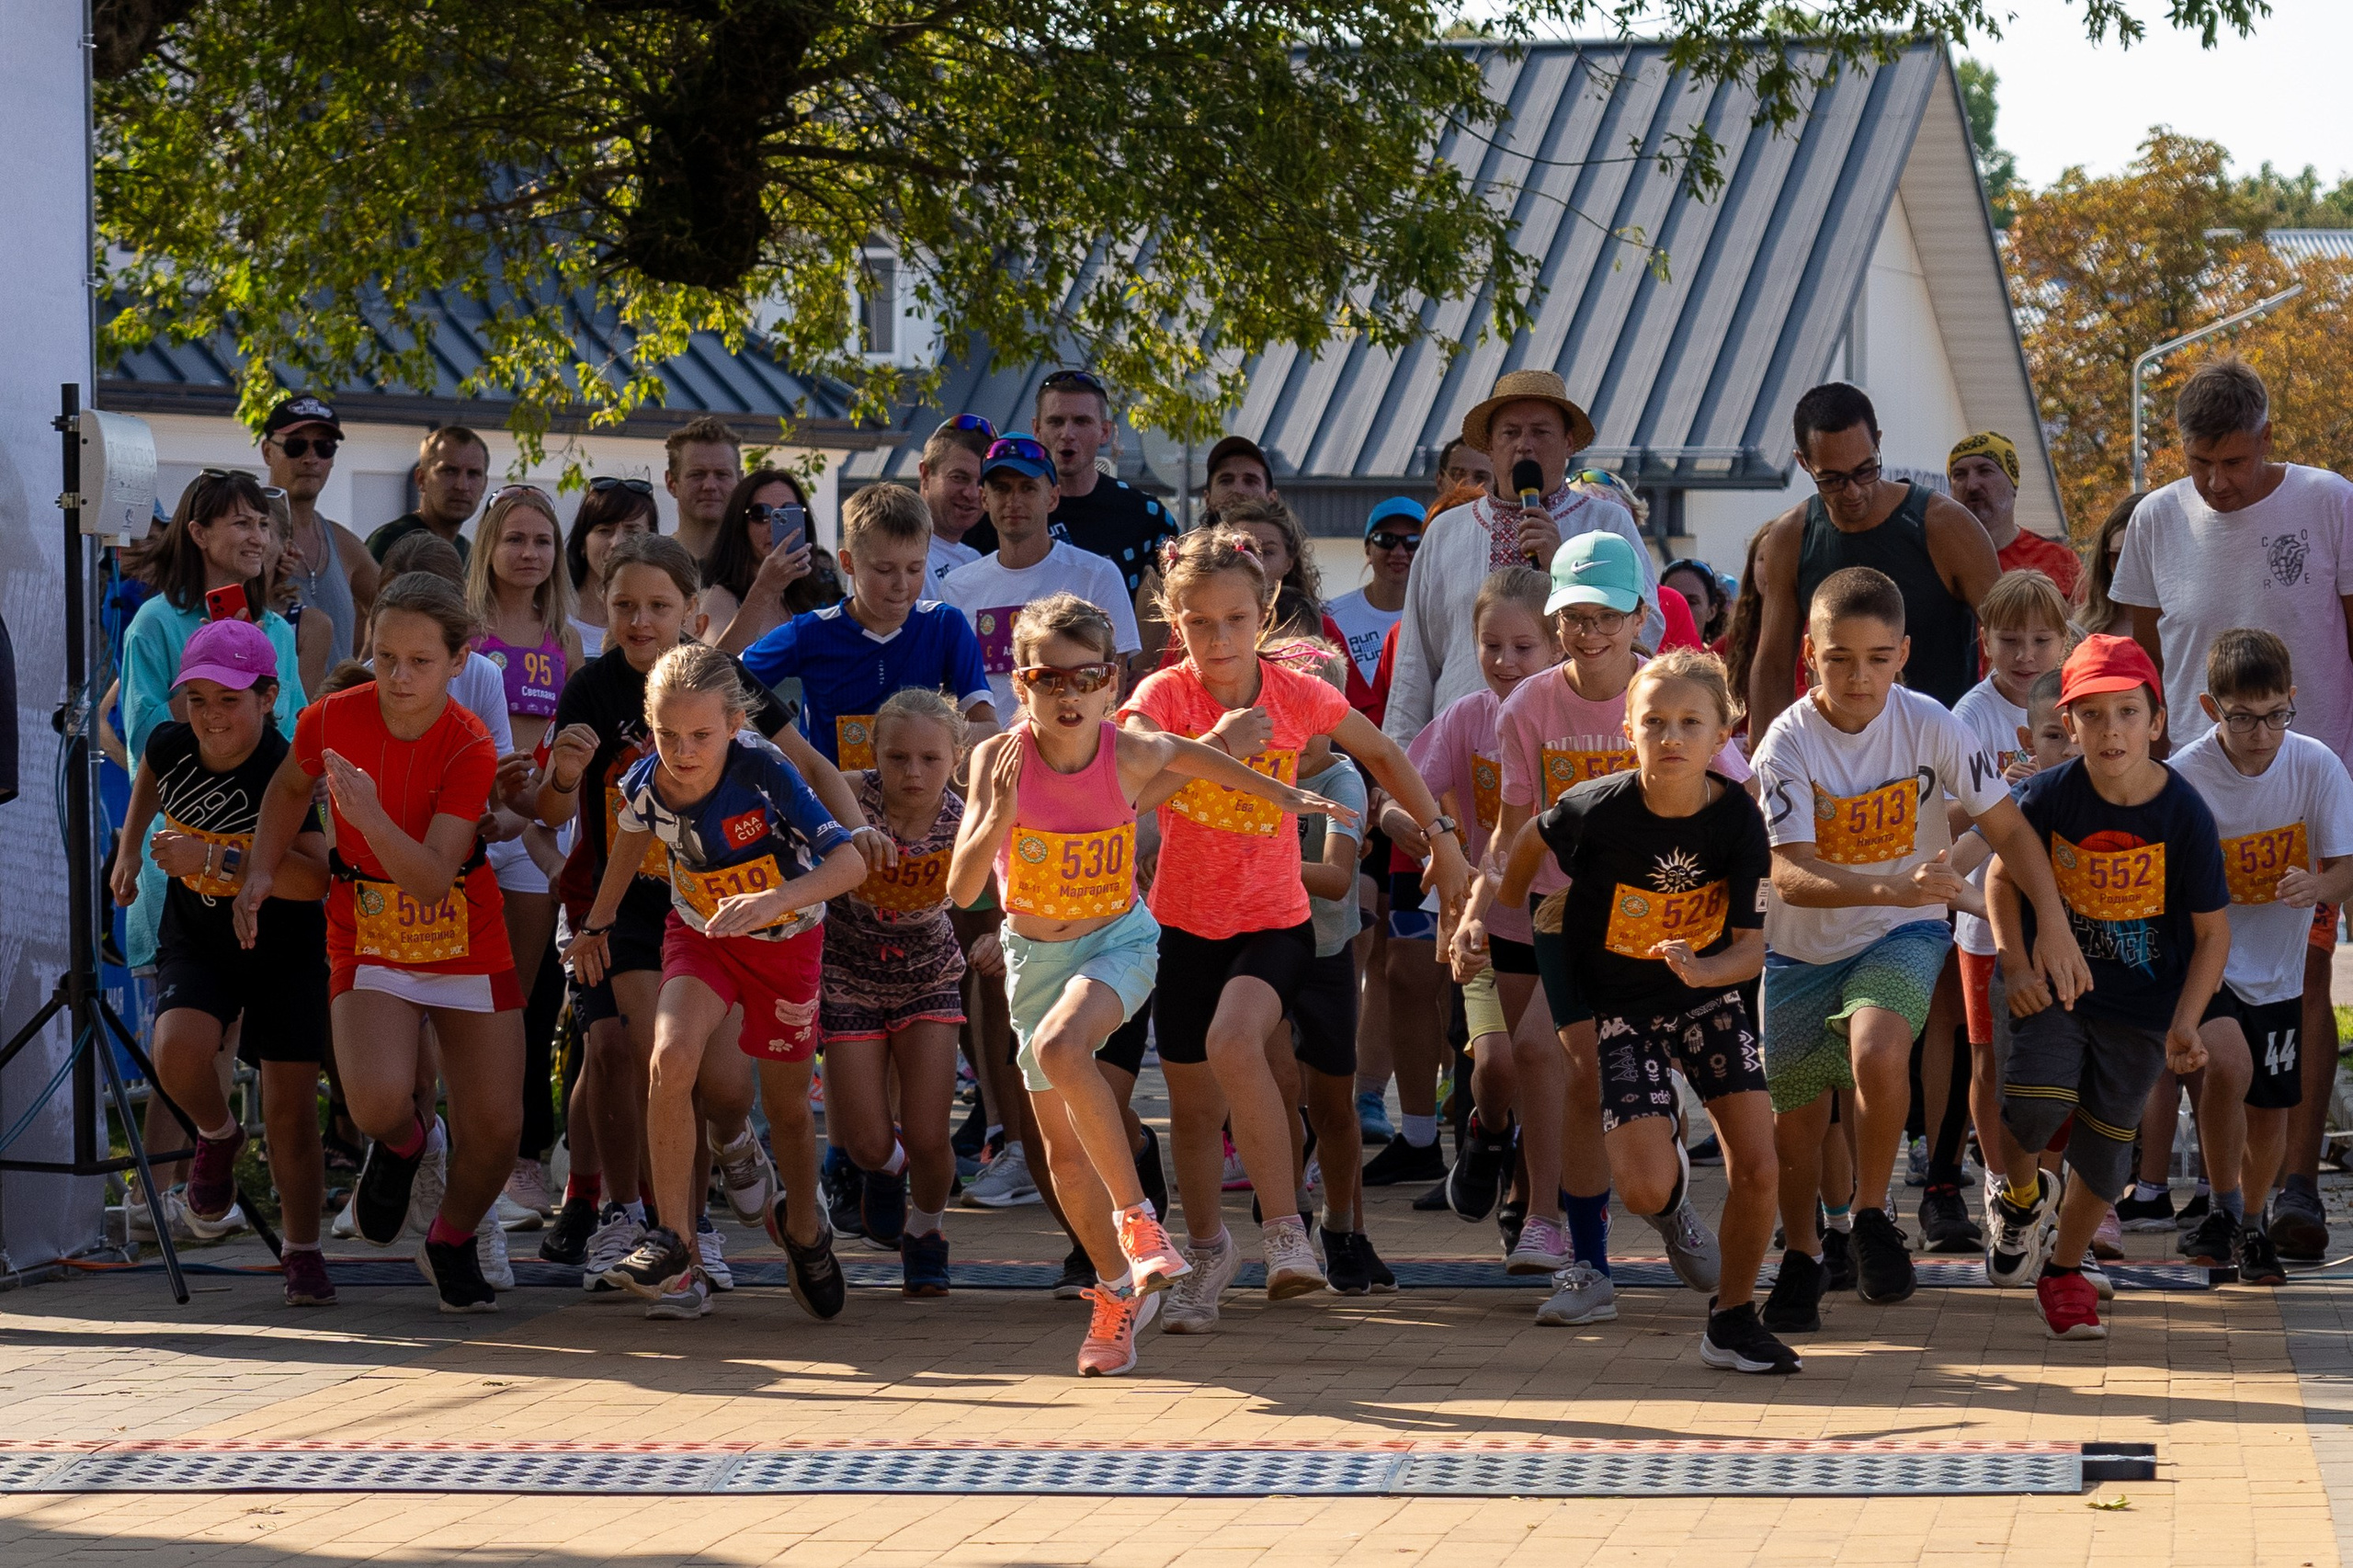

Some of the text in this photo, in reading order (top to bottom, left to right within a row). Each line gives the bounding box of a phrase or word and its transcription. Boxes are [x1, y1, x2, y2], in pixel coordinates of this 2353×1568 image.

[524, 652, 552, 687] 95
[520, 685, 557, 701] Светлана
[1234, 799, 1255, 813] Ева
[1848, 789, 1906, 835] 513
[735, 816, 760, 834] AAA
[737, 823, 763, 841] CUP
[1858, 833, 1895, 847] Никита
[1061, 834, 1124, 881] 530
[2239, 830, 2295, 875] 537
[703, 867, 768, 905] 519
[881, 859, 941, 888] 559
[2089, 852, 2153, 891] 552
[1058, 881, 1120, 899] Маргарита
[2099, 892, 2143, 904] Родион
[398, 888, 458, 927] 504
[1661, 884, 1723, 930] 528
[400, 928, 456, 944] Екатерина
[2264, 1028, 2297, 1076] 44
